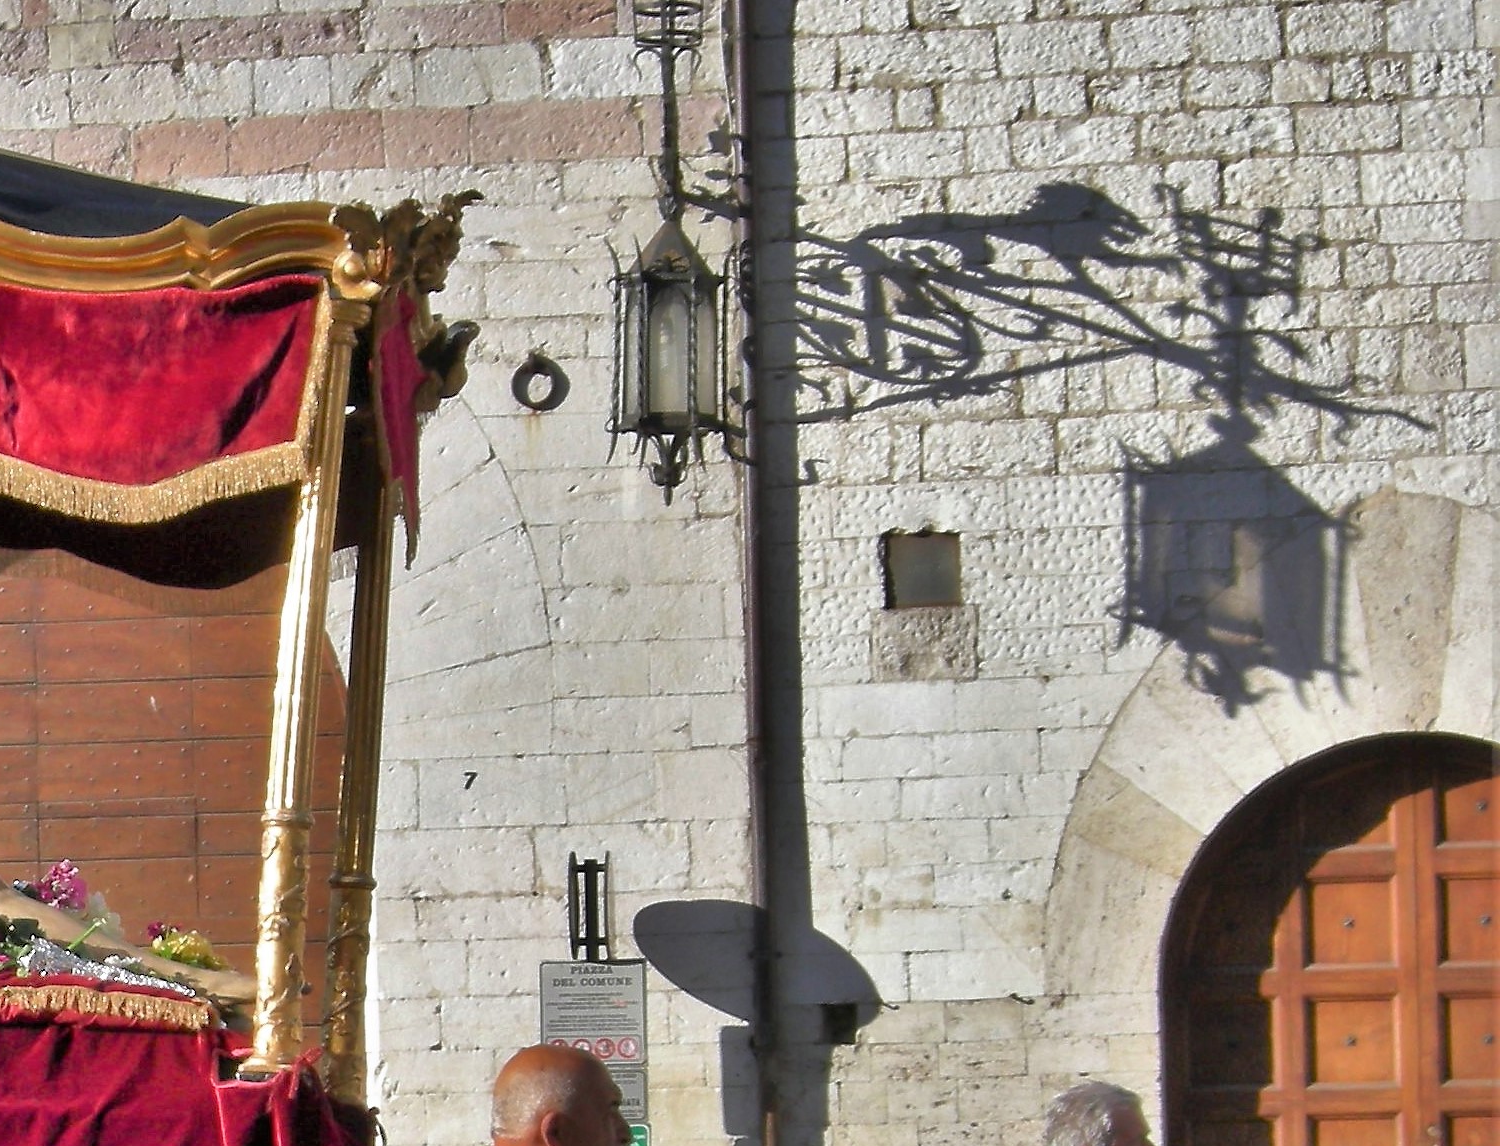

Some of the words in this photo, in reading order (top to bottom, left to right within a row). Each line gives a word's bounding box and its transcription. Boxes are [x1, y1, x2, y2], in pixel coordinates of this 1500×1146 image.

[463, 771, 478, 790] 7
[570, 966, 614, 975] PIAZZA
[552, 978, 577, 987] DEL
[580, 977, 633, 987] COMUNE
